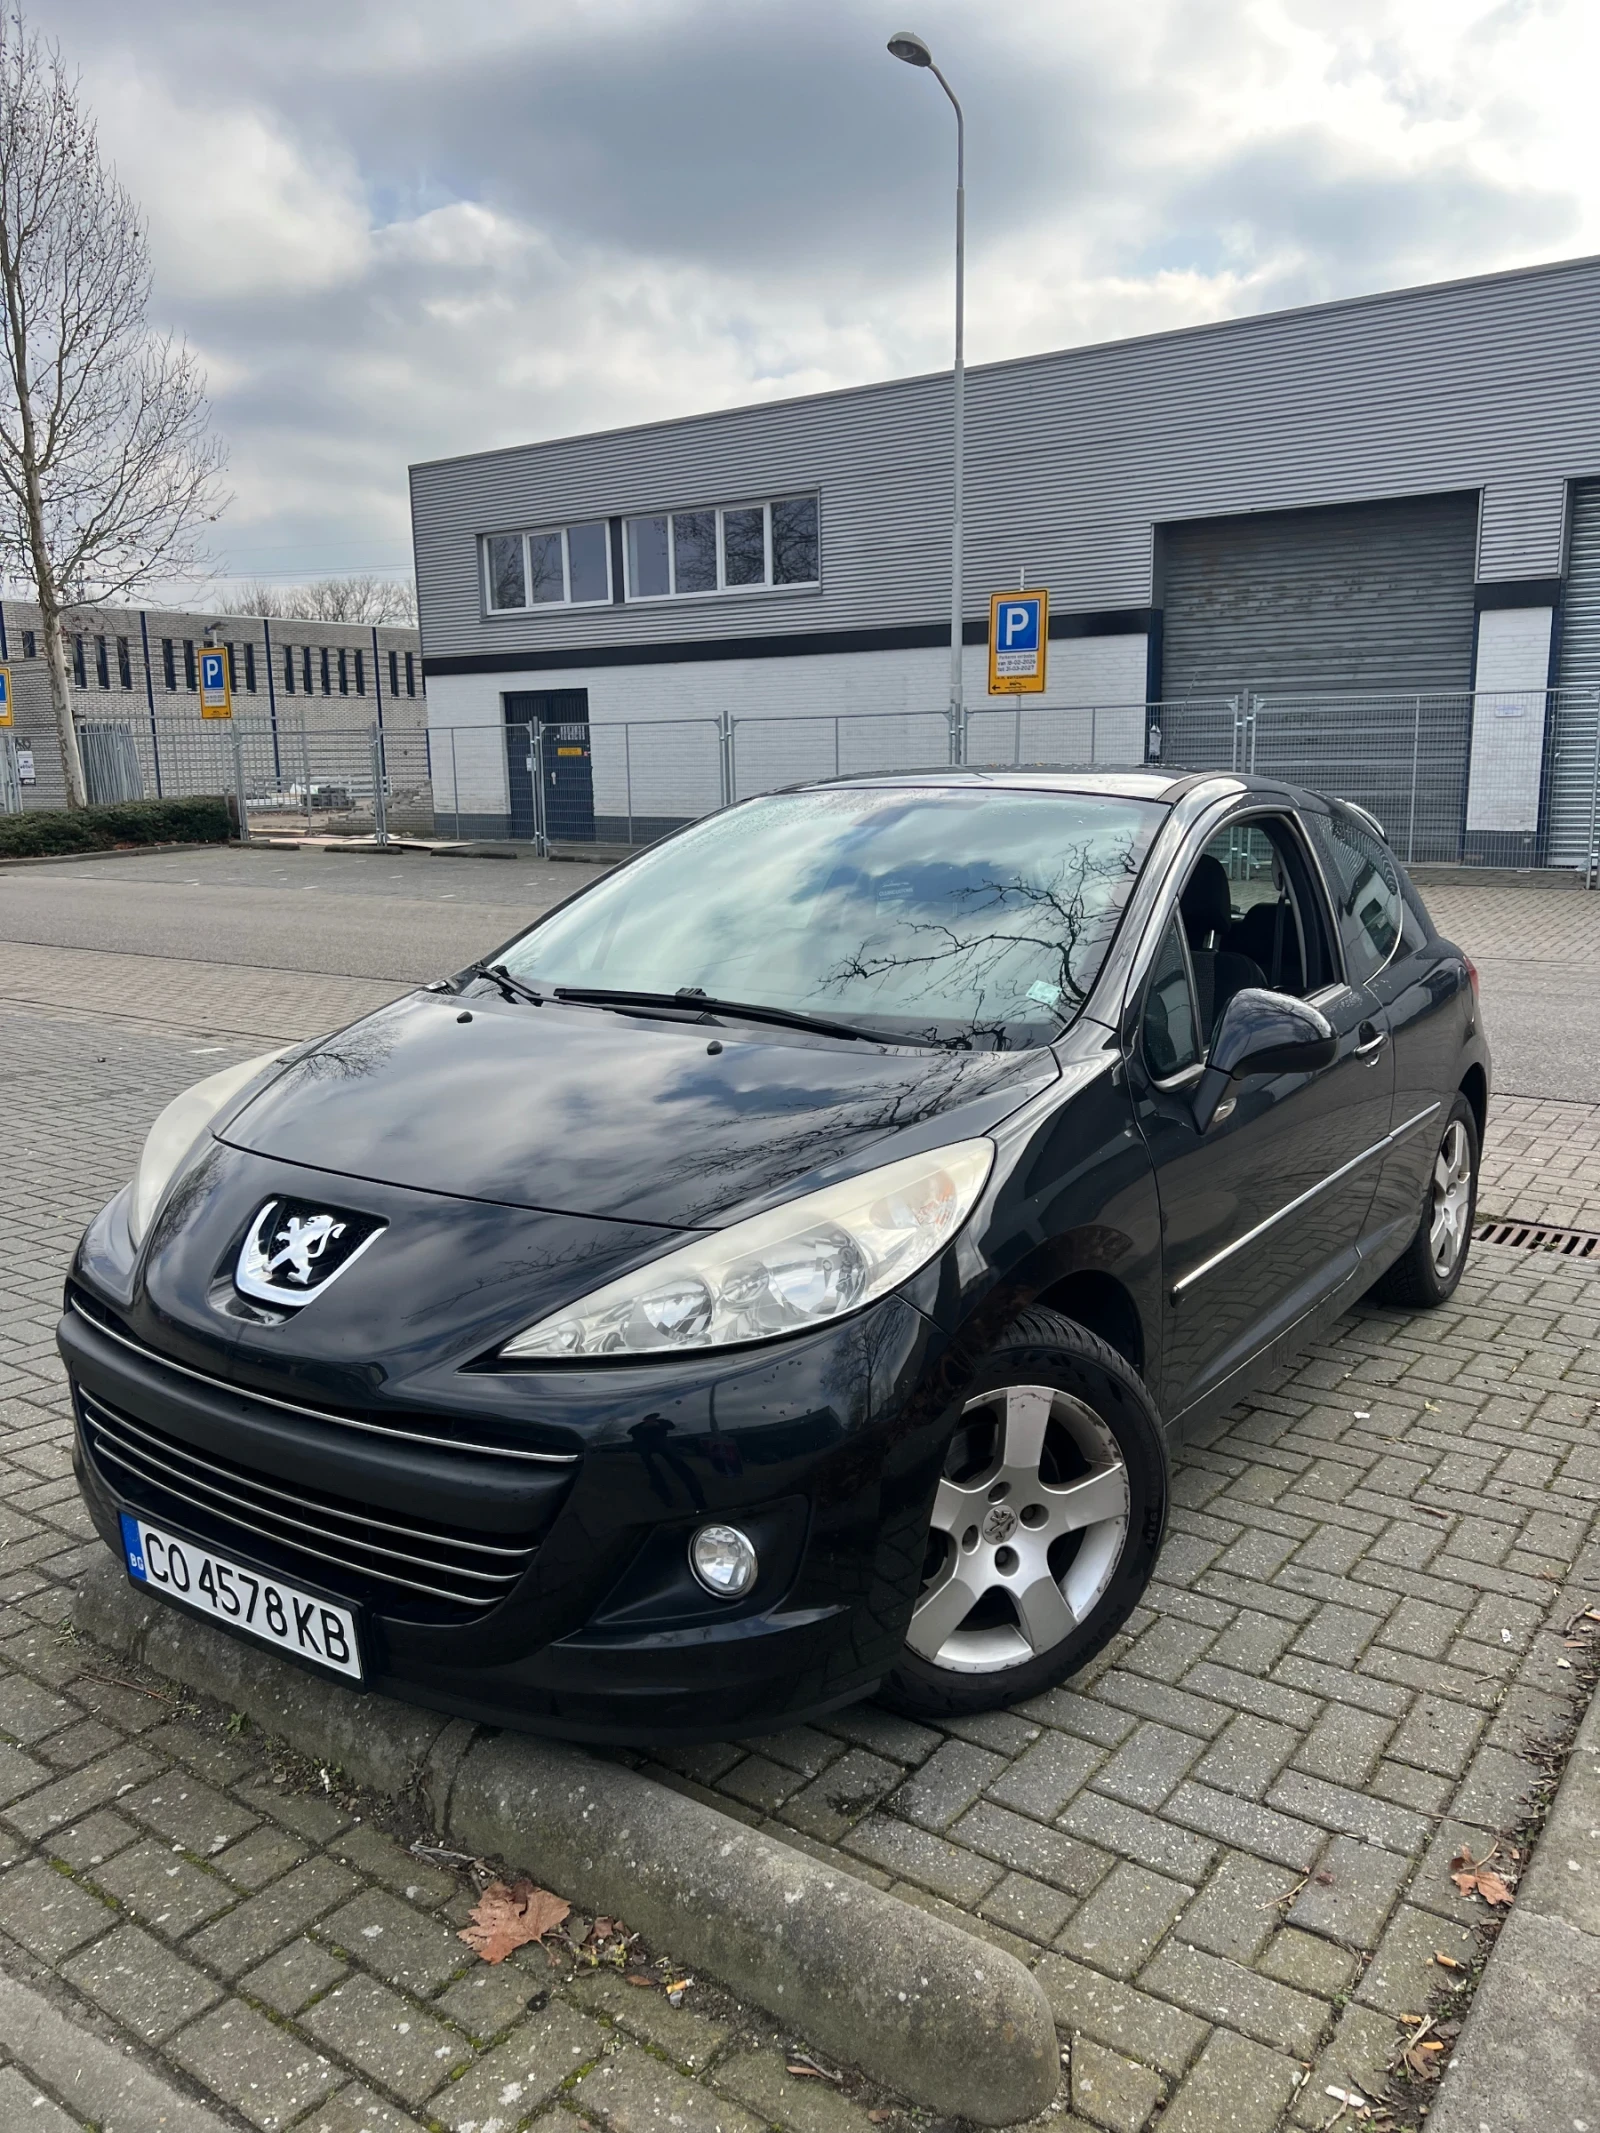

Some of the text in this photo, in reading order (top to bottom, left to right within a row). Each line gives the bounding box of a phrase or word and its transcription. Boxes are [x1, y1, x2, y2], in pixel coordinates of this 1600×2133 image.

[1006, 607, 1029, 646] P
[207, 659, 218, 685] P
[130, 1552, 144, 1571] BG
[145, 1532, 350, 1665] CO 4578 KB
